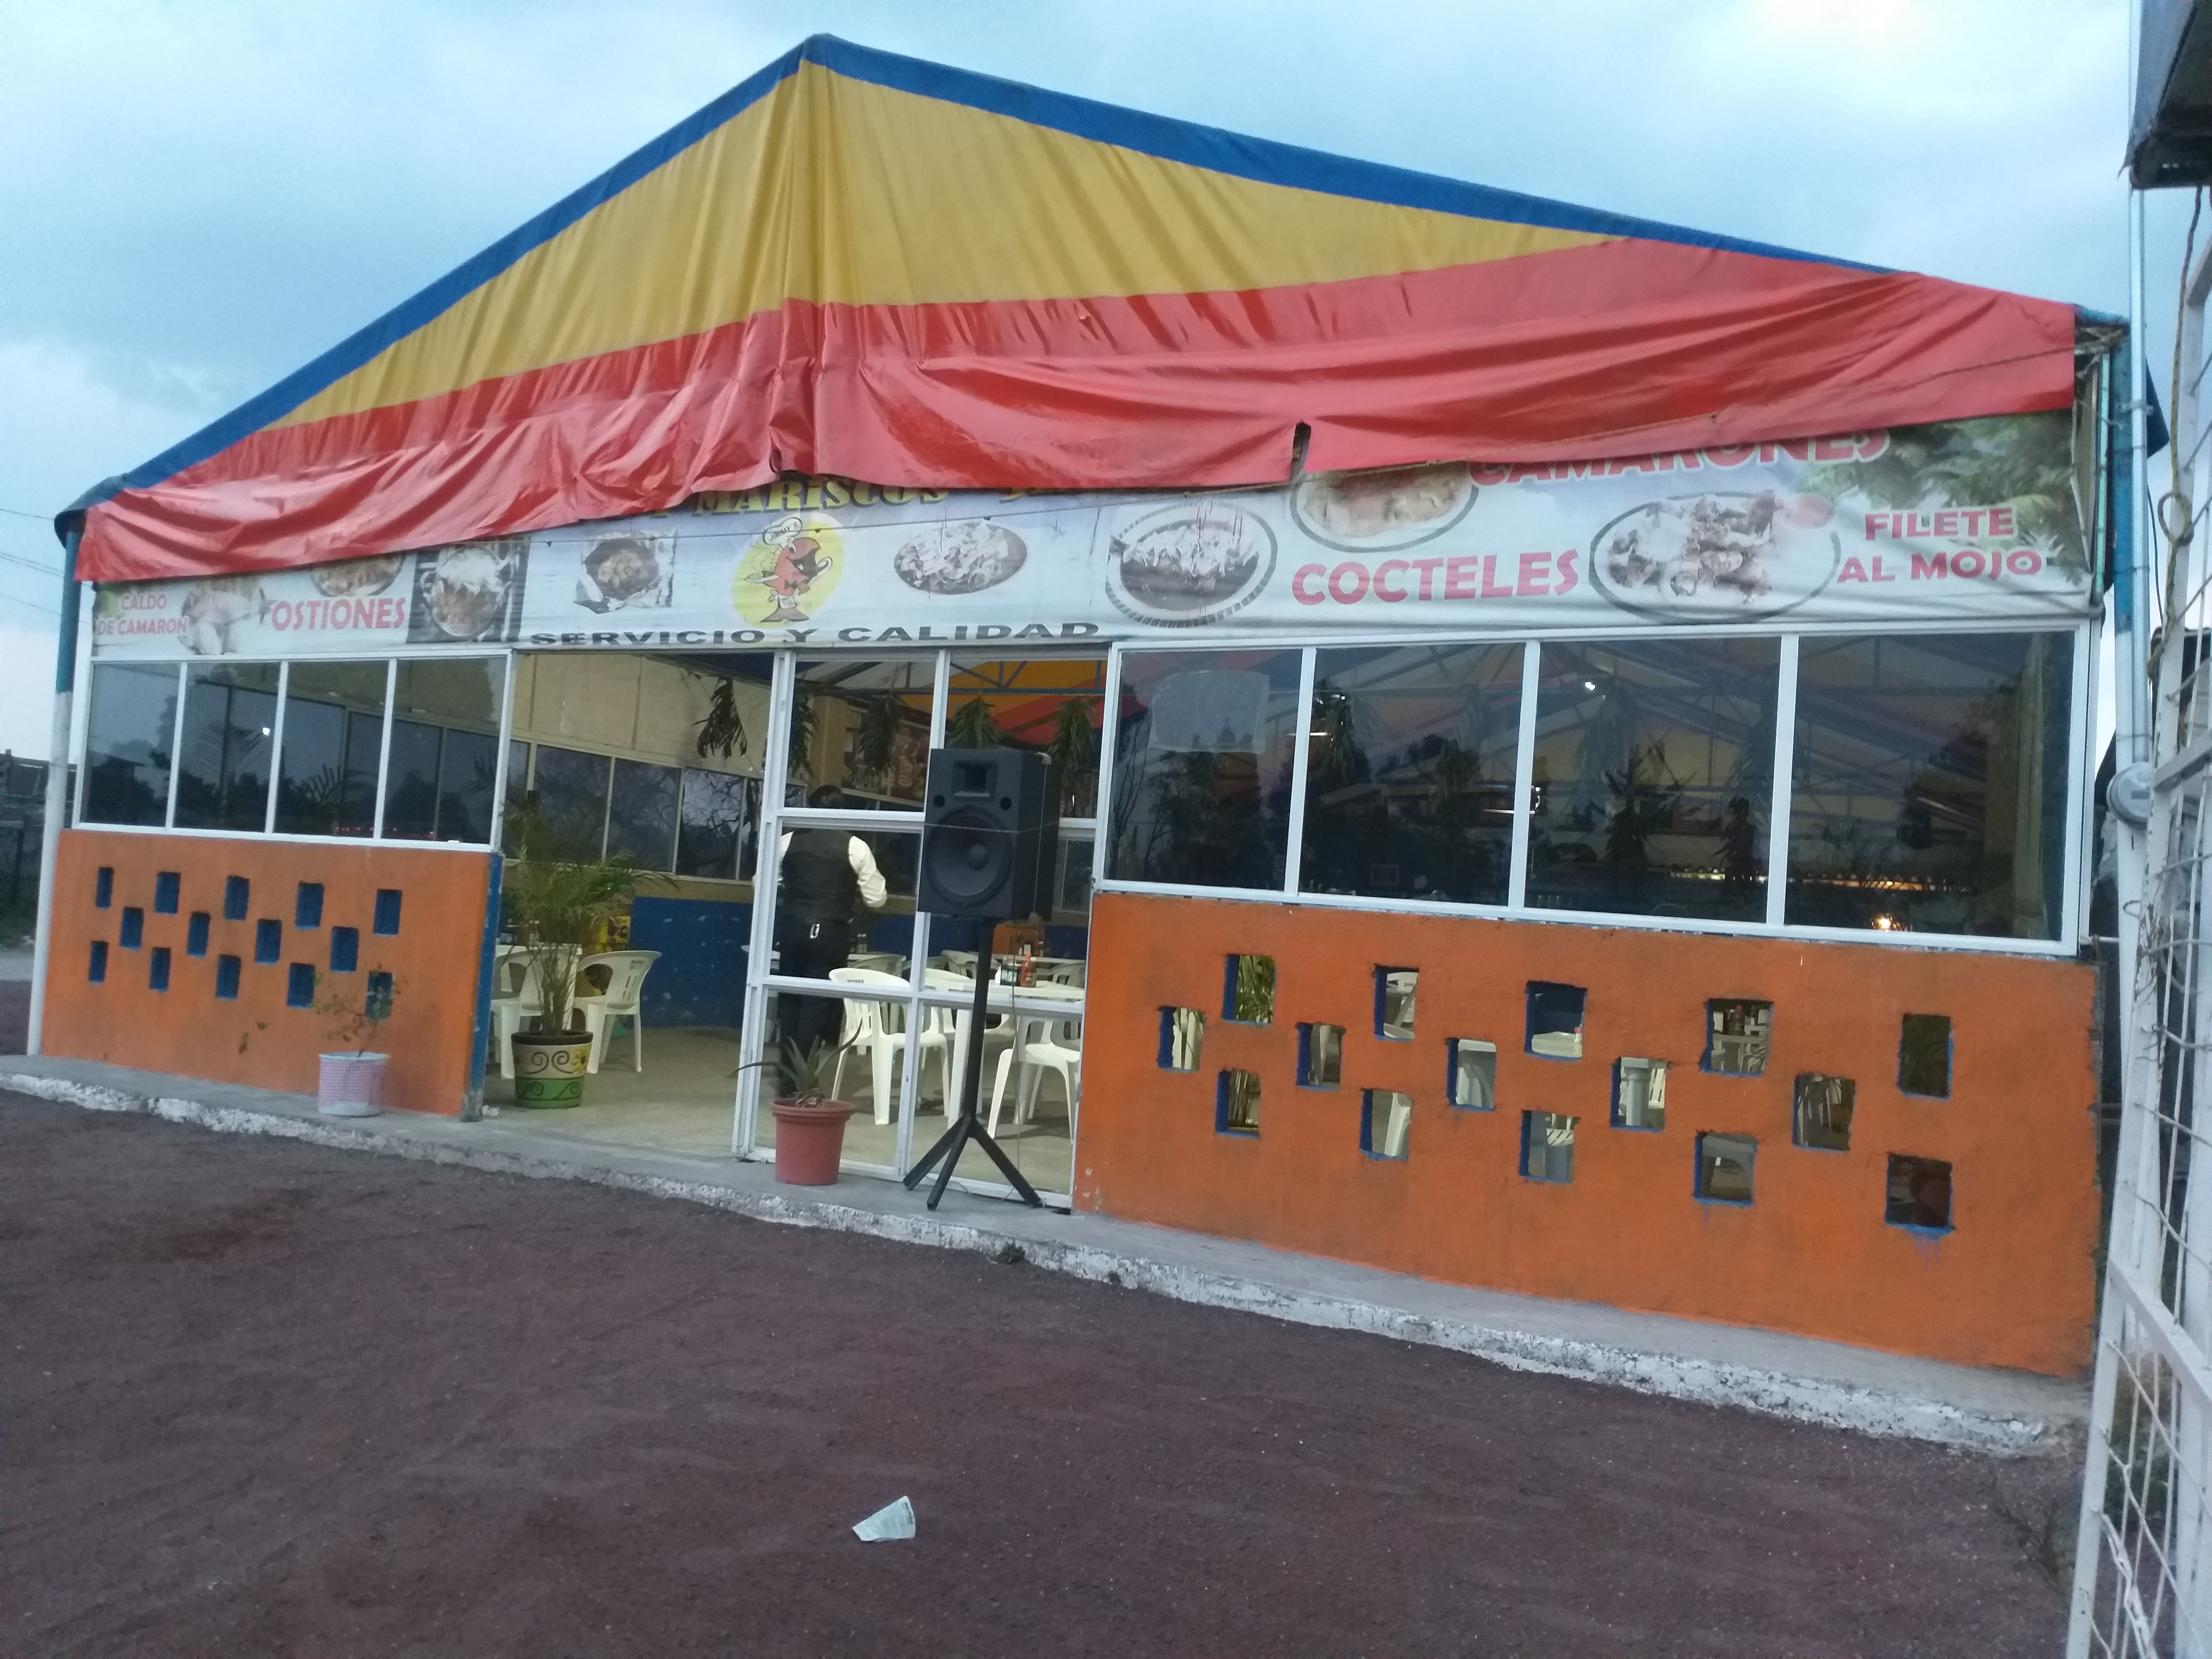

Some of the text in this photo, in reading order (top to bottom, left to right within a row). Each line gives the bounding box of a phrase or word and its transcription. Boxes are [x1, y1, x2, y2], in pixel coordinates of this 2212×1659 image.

[1864, 507, 2014, 541] FILETE
[1291, 549, 1580, 606] COCTELES
[1838, 550, 2043, 583] AL MOJO
[121, 593, 168, 611] CALDO
[272, 596, 407, 631] OSTIONES
[96, 618, 187, 636] DE CAMARON
[530, 622, 1100, 646] SERVICIO Y CALIDAD
